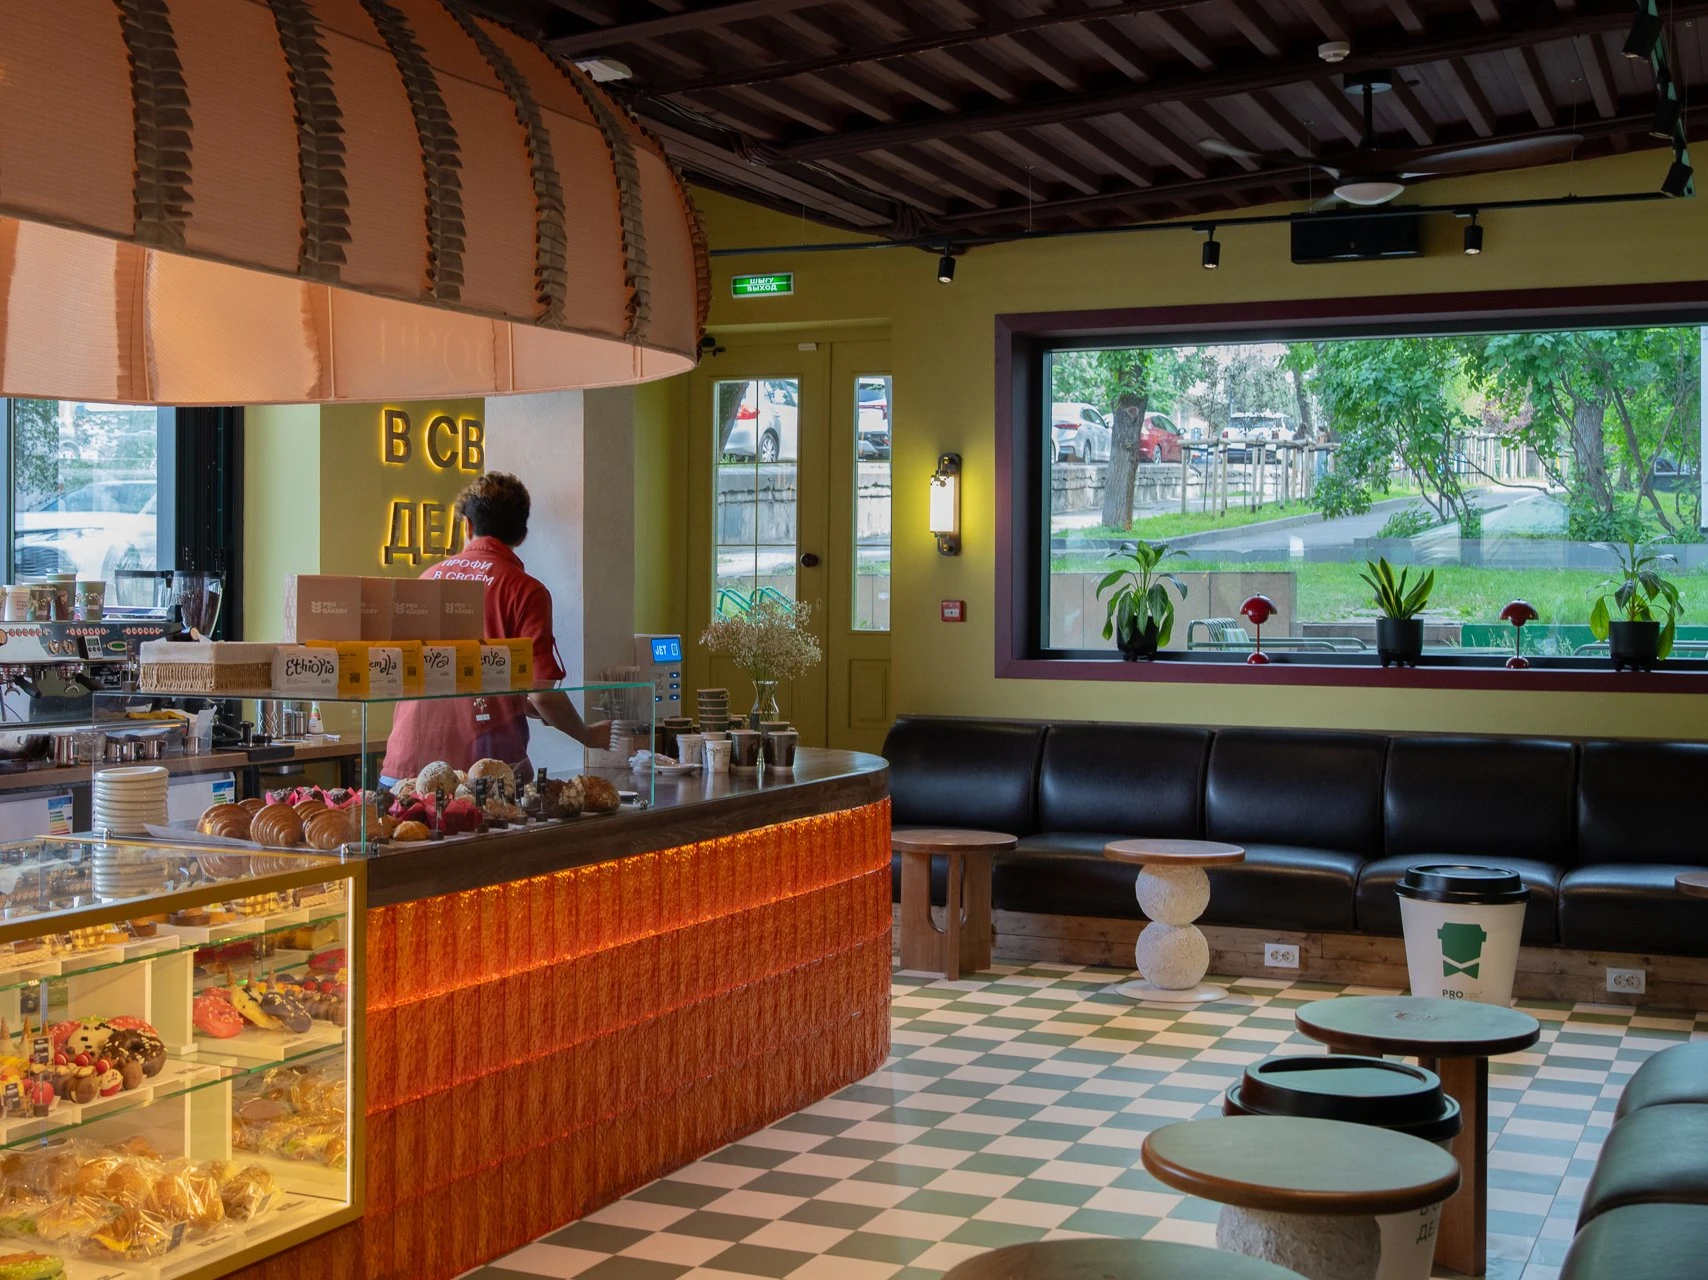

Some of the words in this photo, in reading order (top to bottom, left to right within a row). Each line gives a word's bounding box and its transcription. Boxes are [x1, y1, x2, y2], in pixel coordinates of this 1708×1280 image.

[747, 284, 778, 292] ВЫХОД
[382, 408, 412, 463] В
[441, 558, 494, 571] ПРОФИ
[322, 607, 349, 615] BAKERY
[655, 645, 667, 656] JET
[285, 656, 335, 677] Ethiopia
[1442, 989, 1464, 999] PRO
